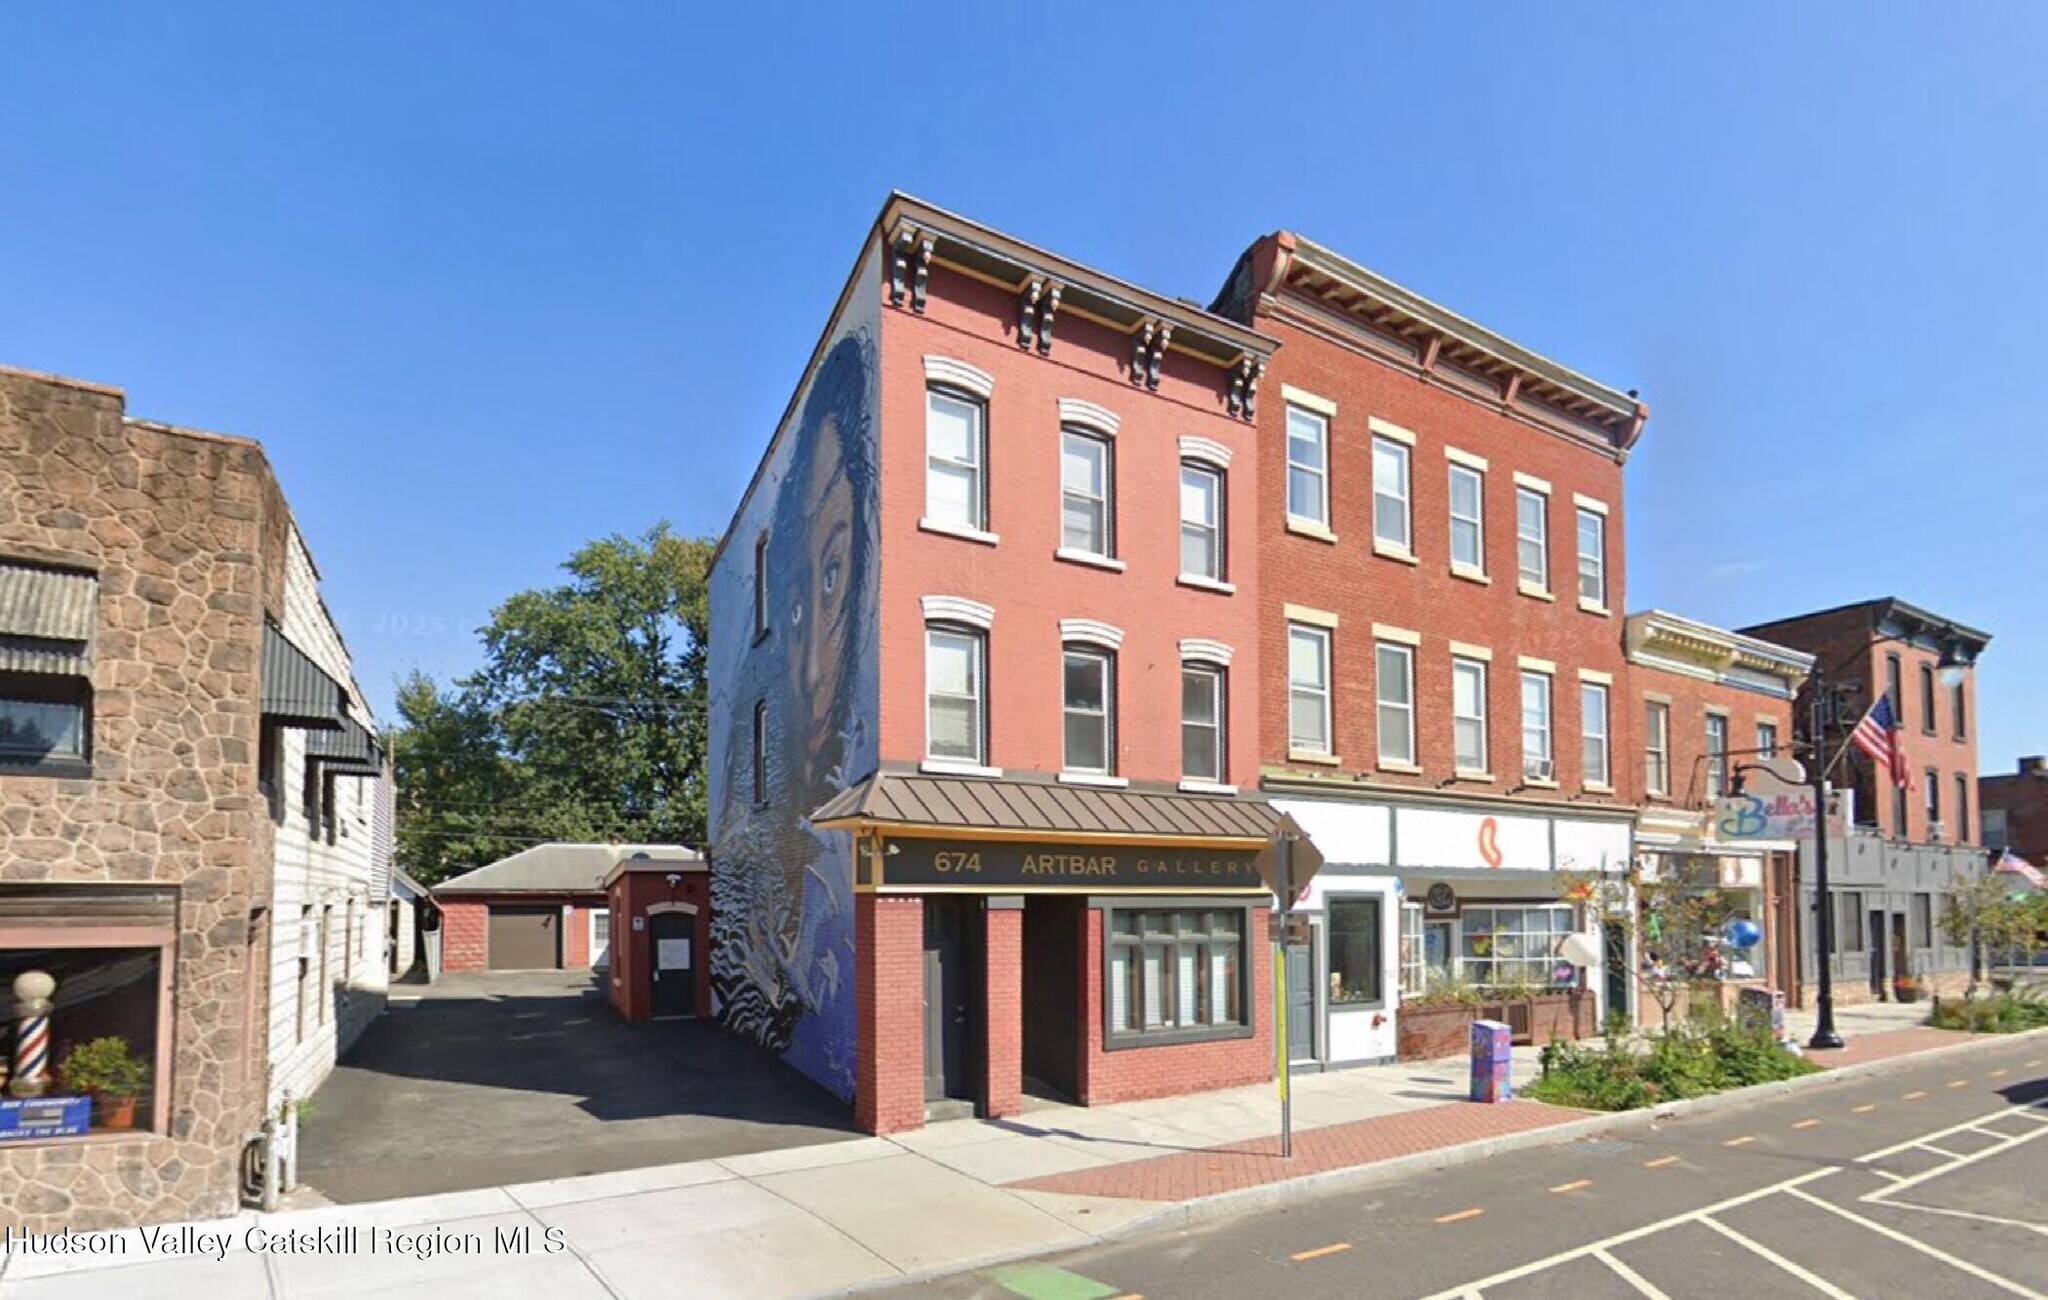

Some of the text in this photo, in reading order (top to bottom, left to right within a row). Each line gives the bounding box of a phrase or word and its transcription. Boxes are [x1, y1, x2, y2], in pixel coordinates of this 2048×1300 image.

[934, 852, 1257, 875] 674 ARTBAR GALLERY
